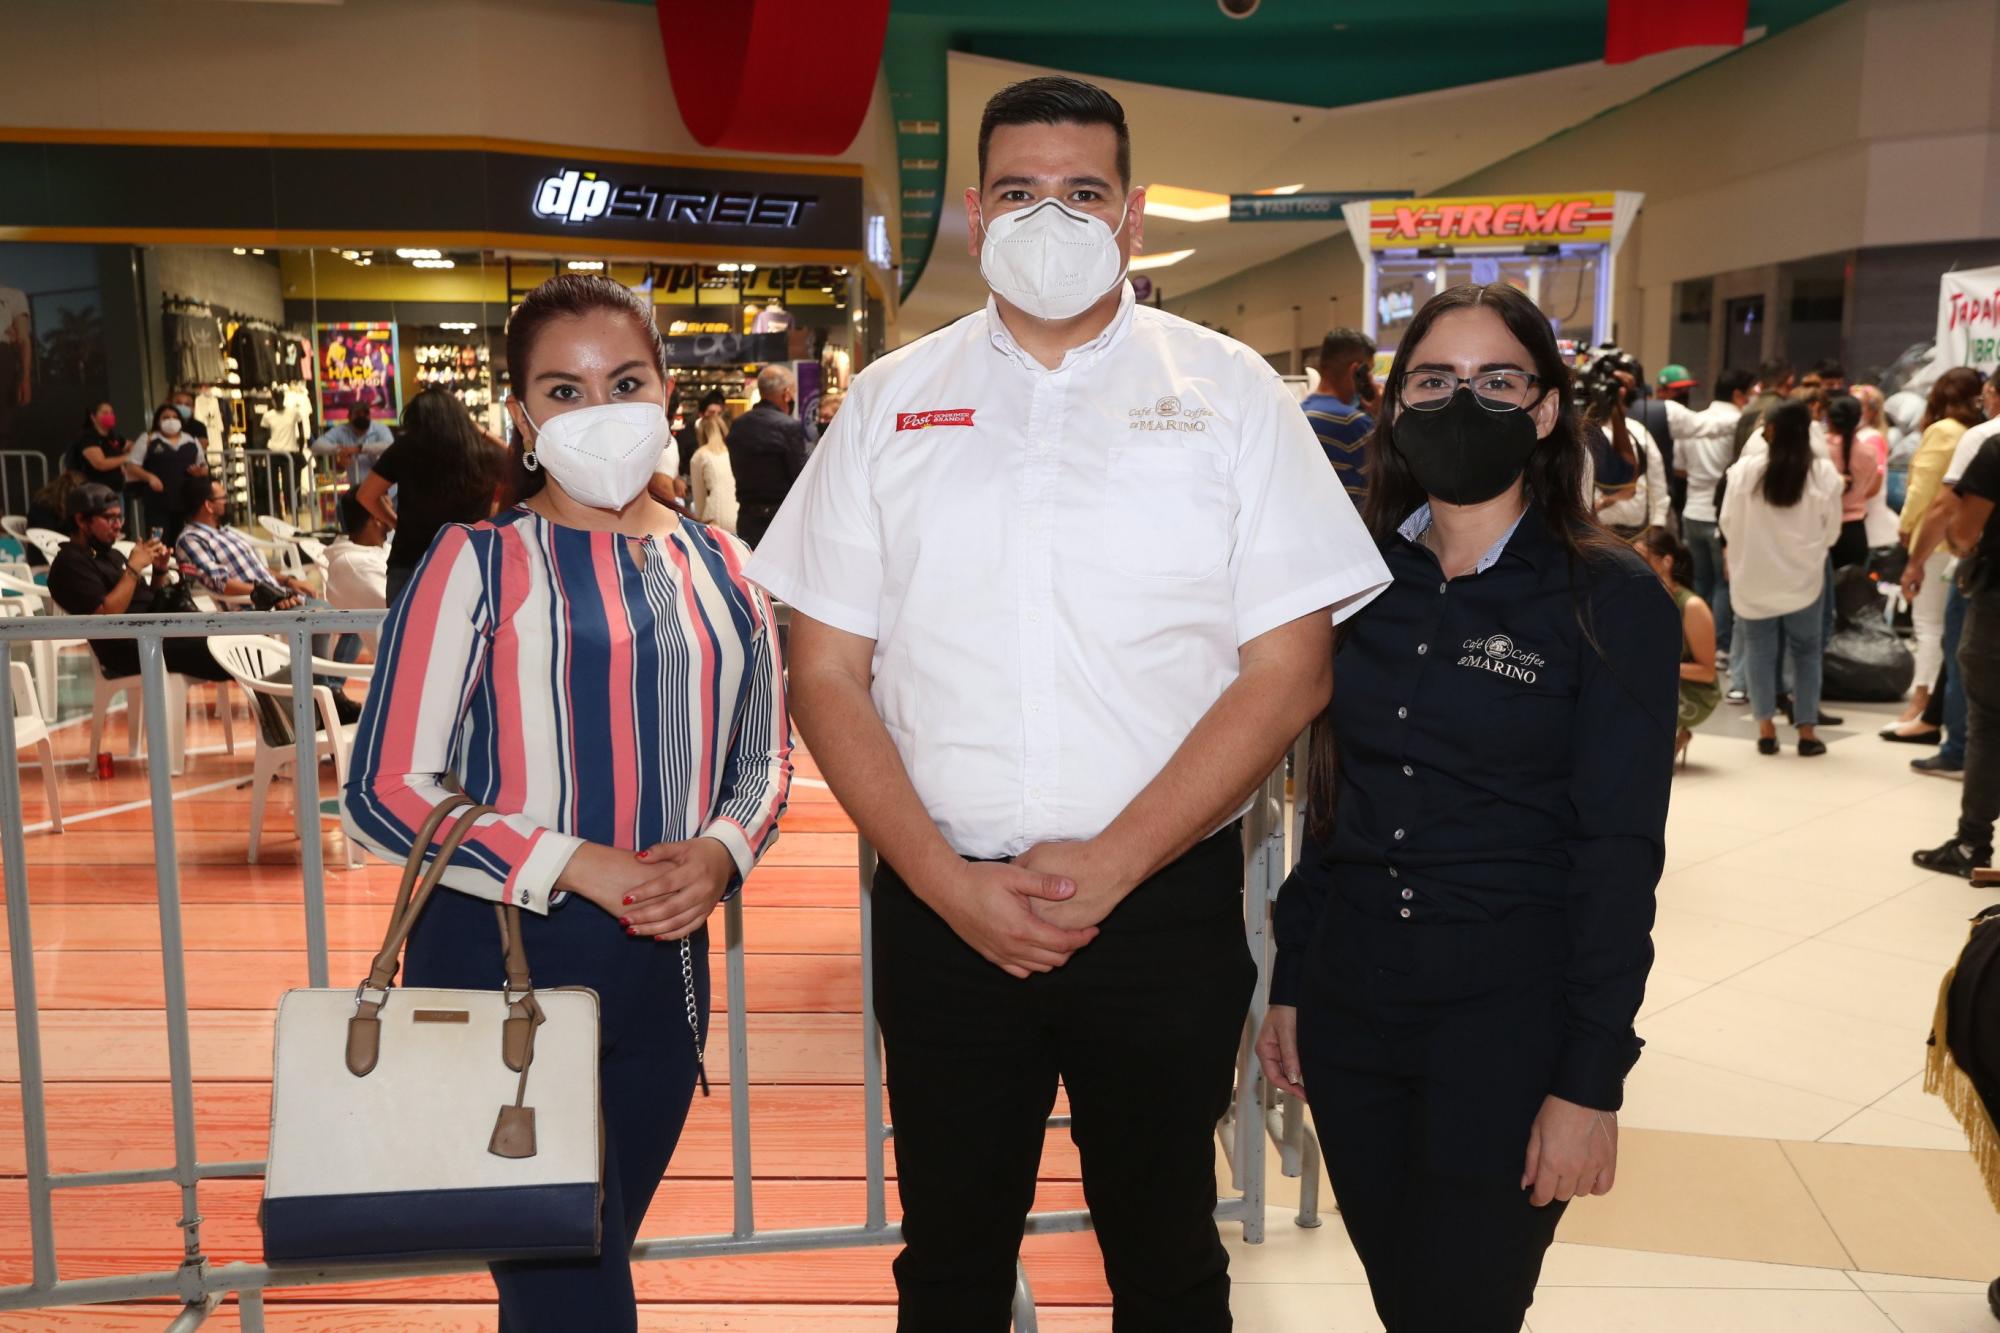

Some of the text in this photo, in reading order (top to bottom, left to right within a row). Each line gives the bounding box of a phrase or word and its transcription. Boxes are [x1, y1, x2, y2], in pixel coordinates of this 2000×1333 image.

[1387, 201, 1592, 240] X-TREME
[903, 413, 932, 429] Post
[1183, 407, 1215, 420] Coffee
[1139, 420, 1206, 432] MARINO
[1511, 649, 1545, 668] Coffee
[1464, 655, 1537, 684] MARINO
